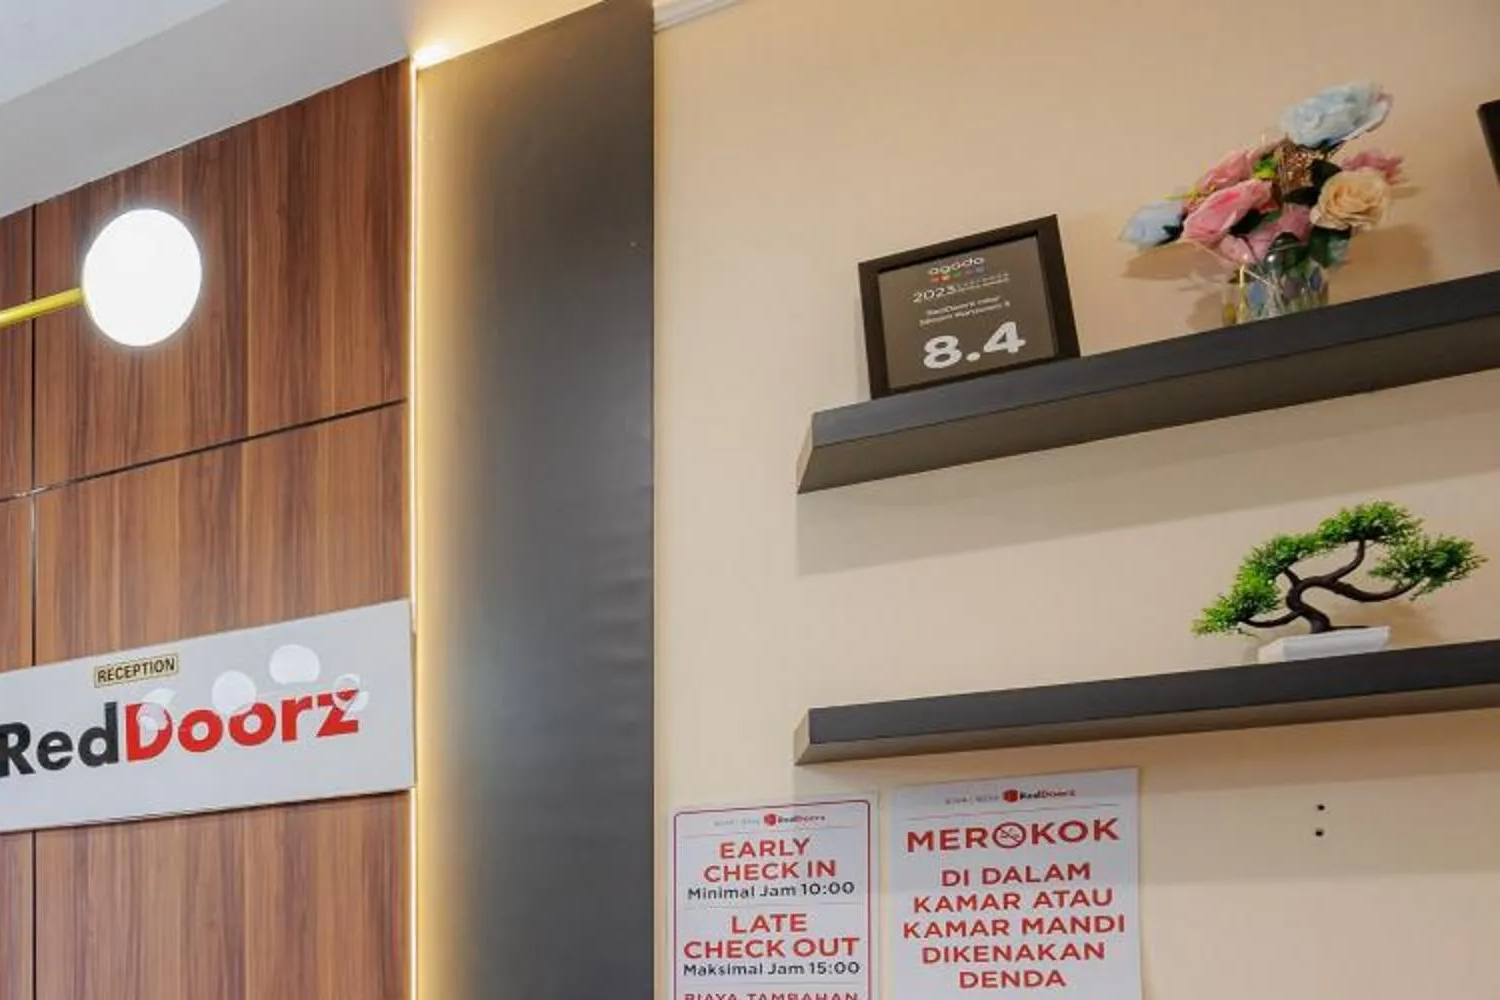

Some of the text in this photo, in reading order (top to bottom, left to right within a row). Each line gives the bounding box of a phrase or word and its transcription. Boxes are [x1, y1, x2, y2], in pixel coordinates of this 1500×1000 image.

[923, 321, 1026, 369] 8.4
[97, 658, 175, 682] RECEPTION
[720, 837, 810, 859] EARLY
[703, 860, 837, 883] CHECK IN
[941, 863, 1091, 886] DI DALAM
[688, 881, 854, 900] Minimal Jam 10:00
[913, 889, 1113, 913] KAMAR ATAU
[731, 913, 807, 933] LATE
[903, 915, 1125, 939] KAMAR MANDI
[683, 937, 860, 959] CHECK OUT
[922, 943, 1105, 964] DIKENAKAN
[683, 961, 860, 976] Maksimal Jam 15:00
[959, 970, 1066, 988] DENDA
